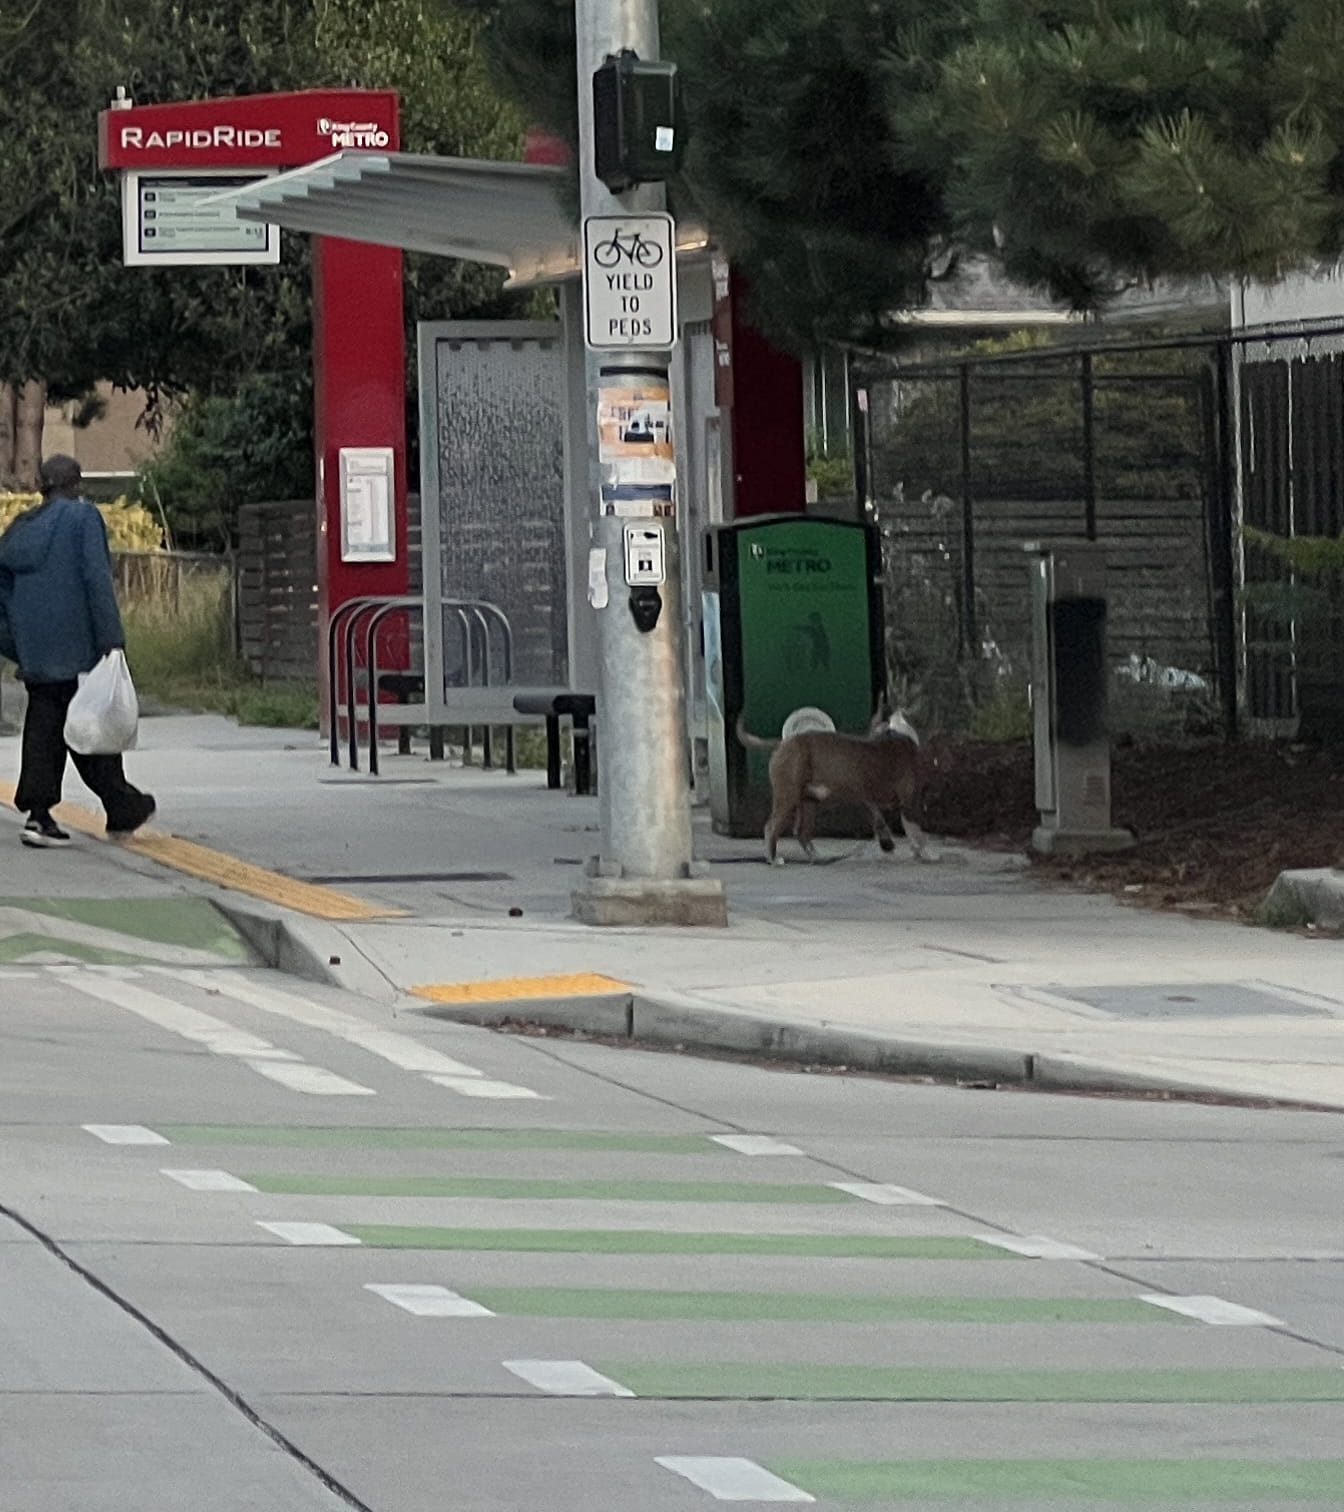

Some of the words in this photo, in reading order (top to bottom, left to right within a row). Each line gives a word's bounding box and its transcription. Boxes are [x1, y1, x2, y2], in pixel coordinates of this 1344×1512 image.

[332, 131, 389, 148] METRO
[606, 273, 653, 291] YIELD
[621, 295, 640, 313] TO
[609, 318, 652, 337] PEDS
